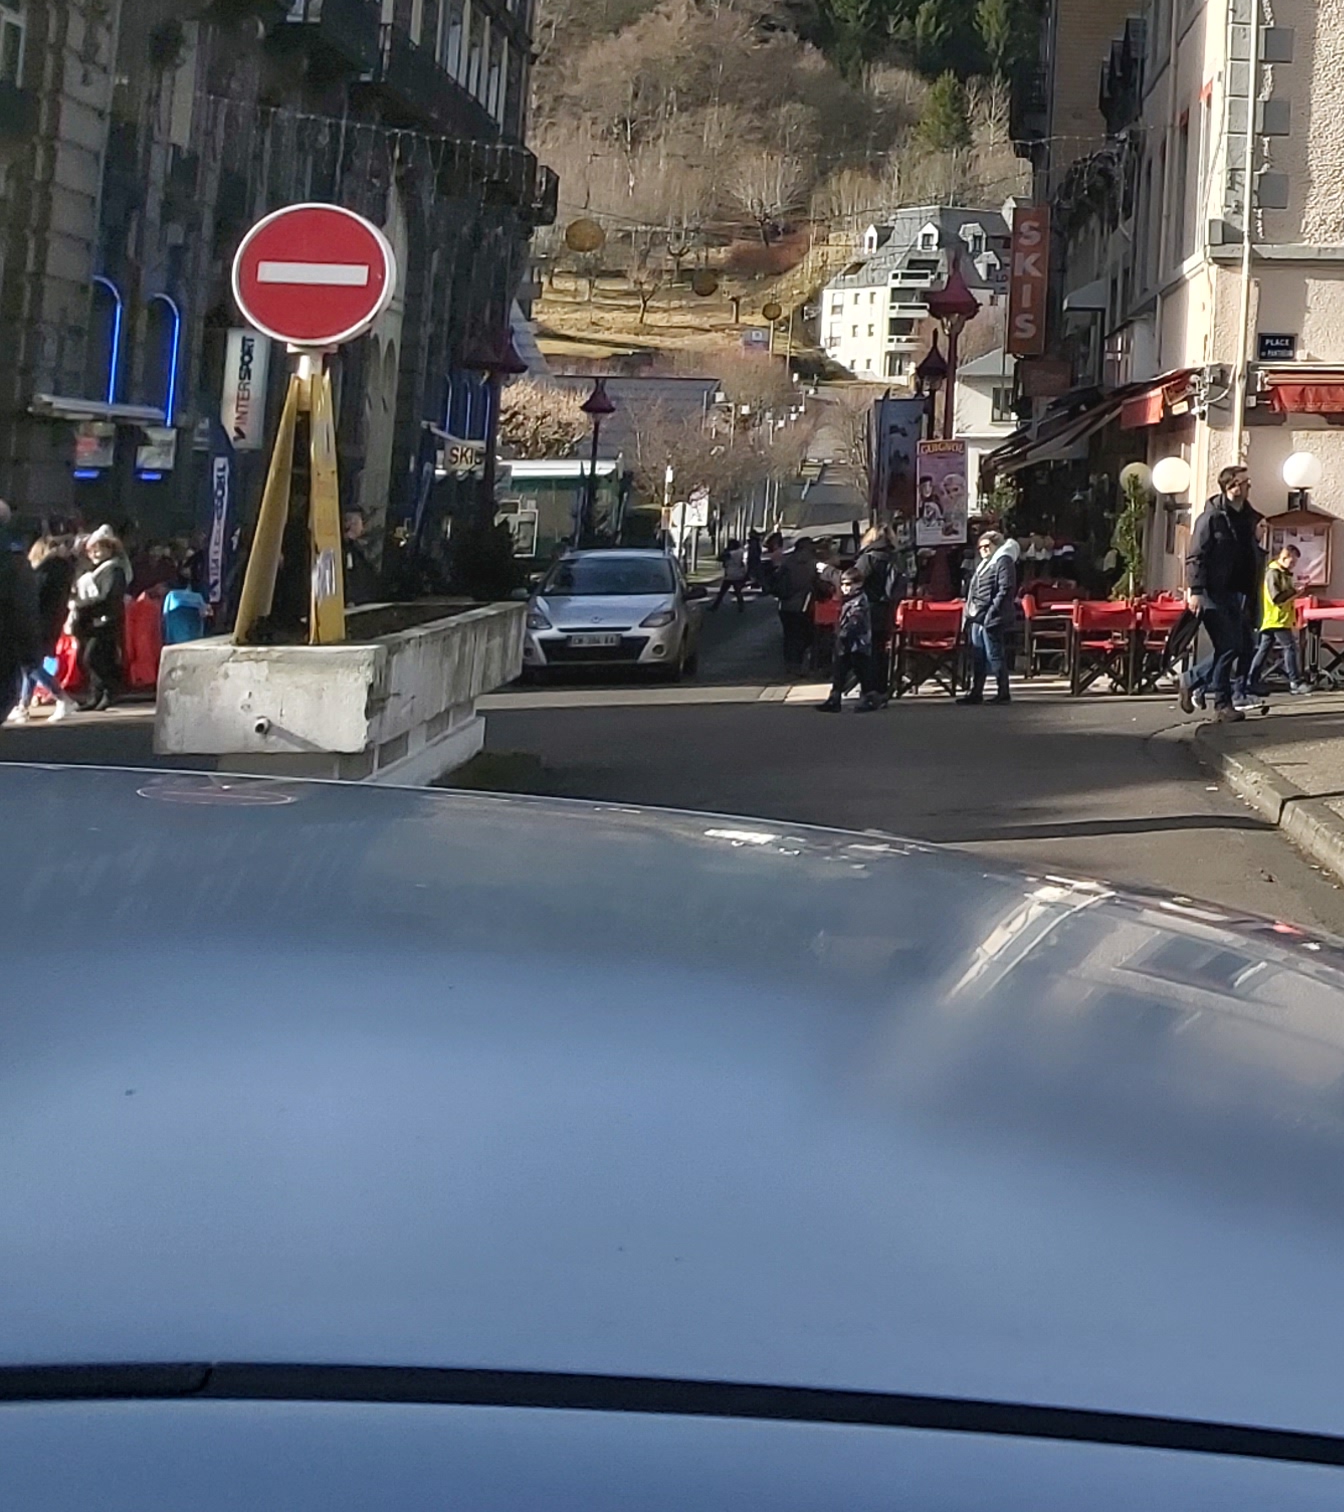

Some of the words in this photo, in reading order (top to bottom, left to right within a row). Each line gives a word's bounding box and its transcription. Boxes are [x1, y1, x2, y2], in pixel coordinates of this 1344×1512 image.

[1013, 220, 1043, 338] SKIS
[234, 335, 255, 426] INTERSPORT
[1264, 338, 1290, 347] PLACE
